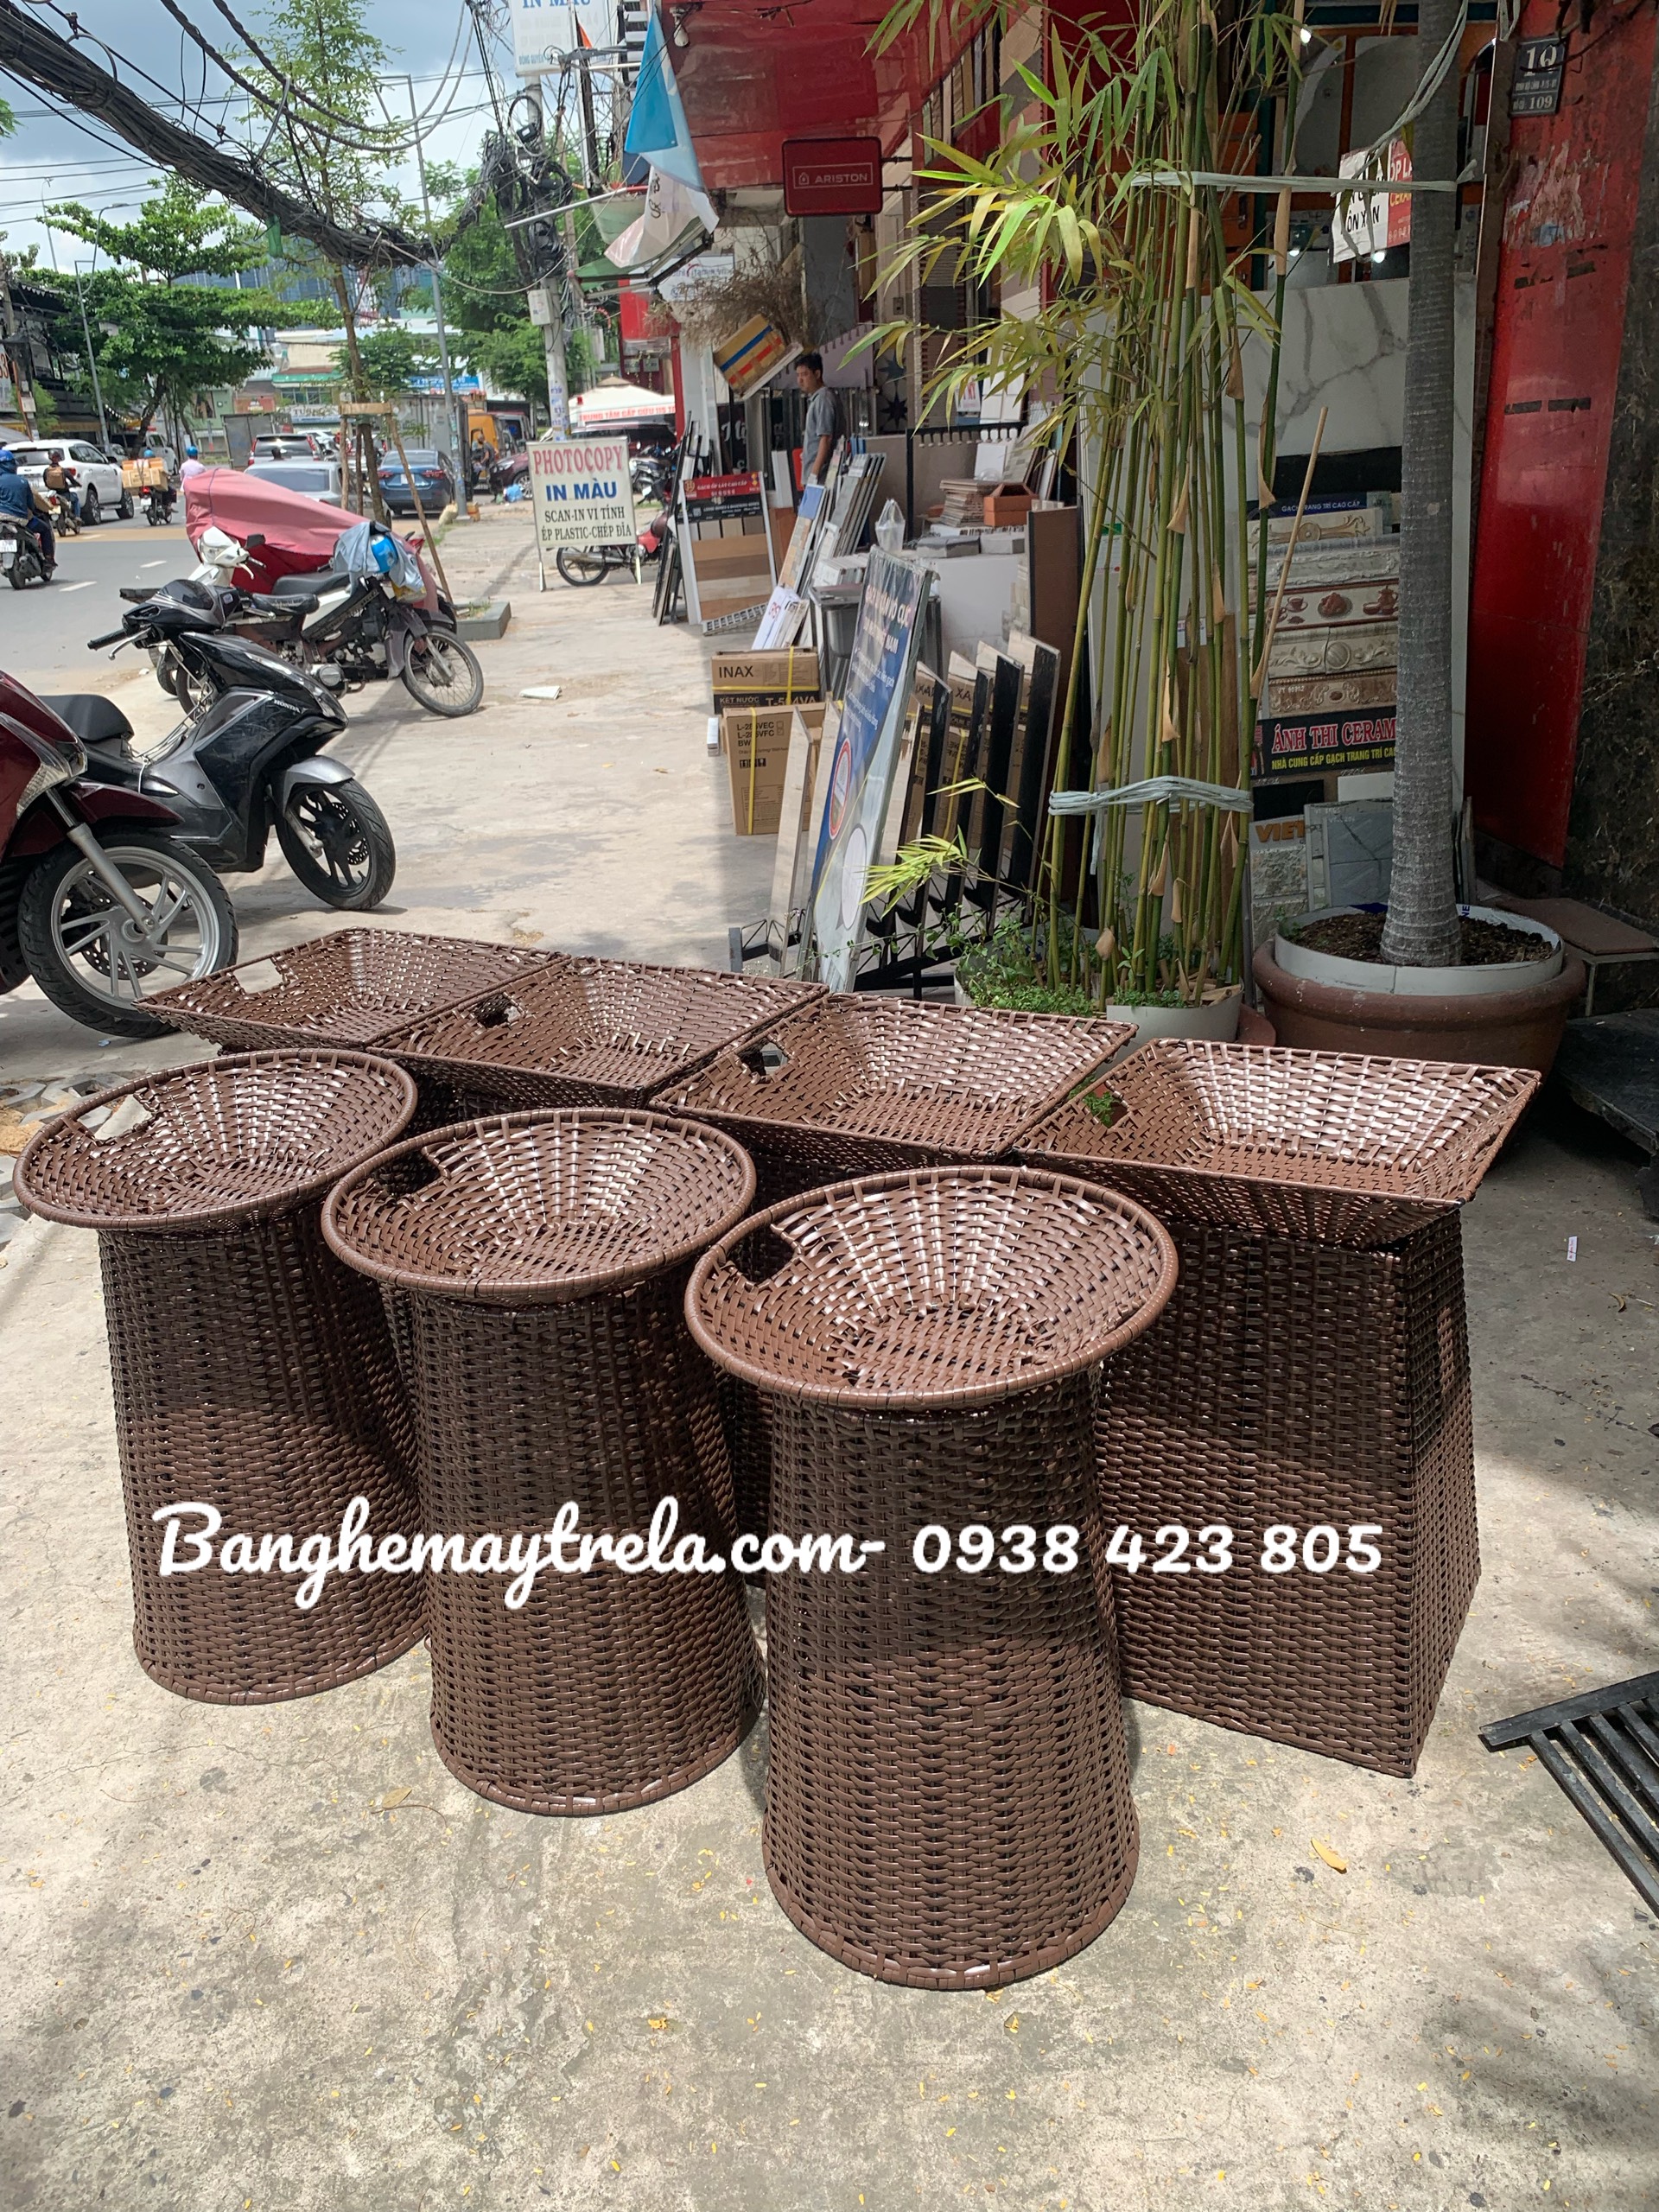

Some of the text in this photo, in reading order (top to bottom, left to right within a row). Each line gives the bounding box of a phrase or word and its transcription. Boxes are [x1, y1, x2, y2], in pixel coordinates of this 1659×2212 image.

[1529, 95, 1553, 110] 109
[815, 174, 868, 184] ARISTON
[532, 446, 623, 475] PHOTOCOPY
[546, 478, 617, 501] IN MÀU
[544, 504, 625, 523] SCAN-IN VI TÍNH
[542, 525, 553, 541] ÉP
[555, 521, 614, 540] PLASTIC-CHÉP
[719, 665, 754, 678] INAX
[274, 699, 301, 713] HONDA
[736, 695, 760, 703] NƯỚC
[1271, 723, 1307, 754] ÁNH
[1309, 723, 1338, 750] THI
[1272, 757, 1287, 770] NHÀ
[1288, 755, 1308, 768] CUNG
[1310, 751, 1324, 766] CẤP
[1325, 752, 1345, 766] GẠCH
[1346, 750, 1370, 762] TRANG
[1370, 746, 1382, 759] TRÍ
[1255, 820, 1306, 843] VIET
